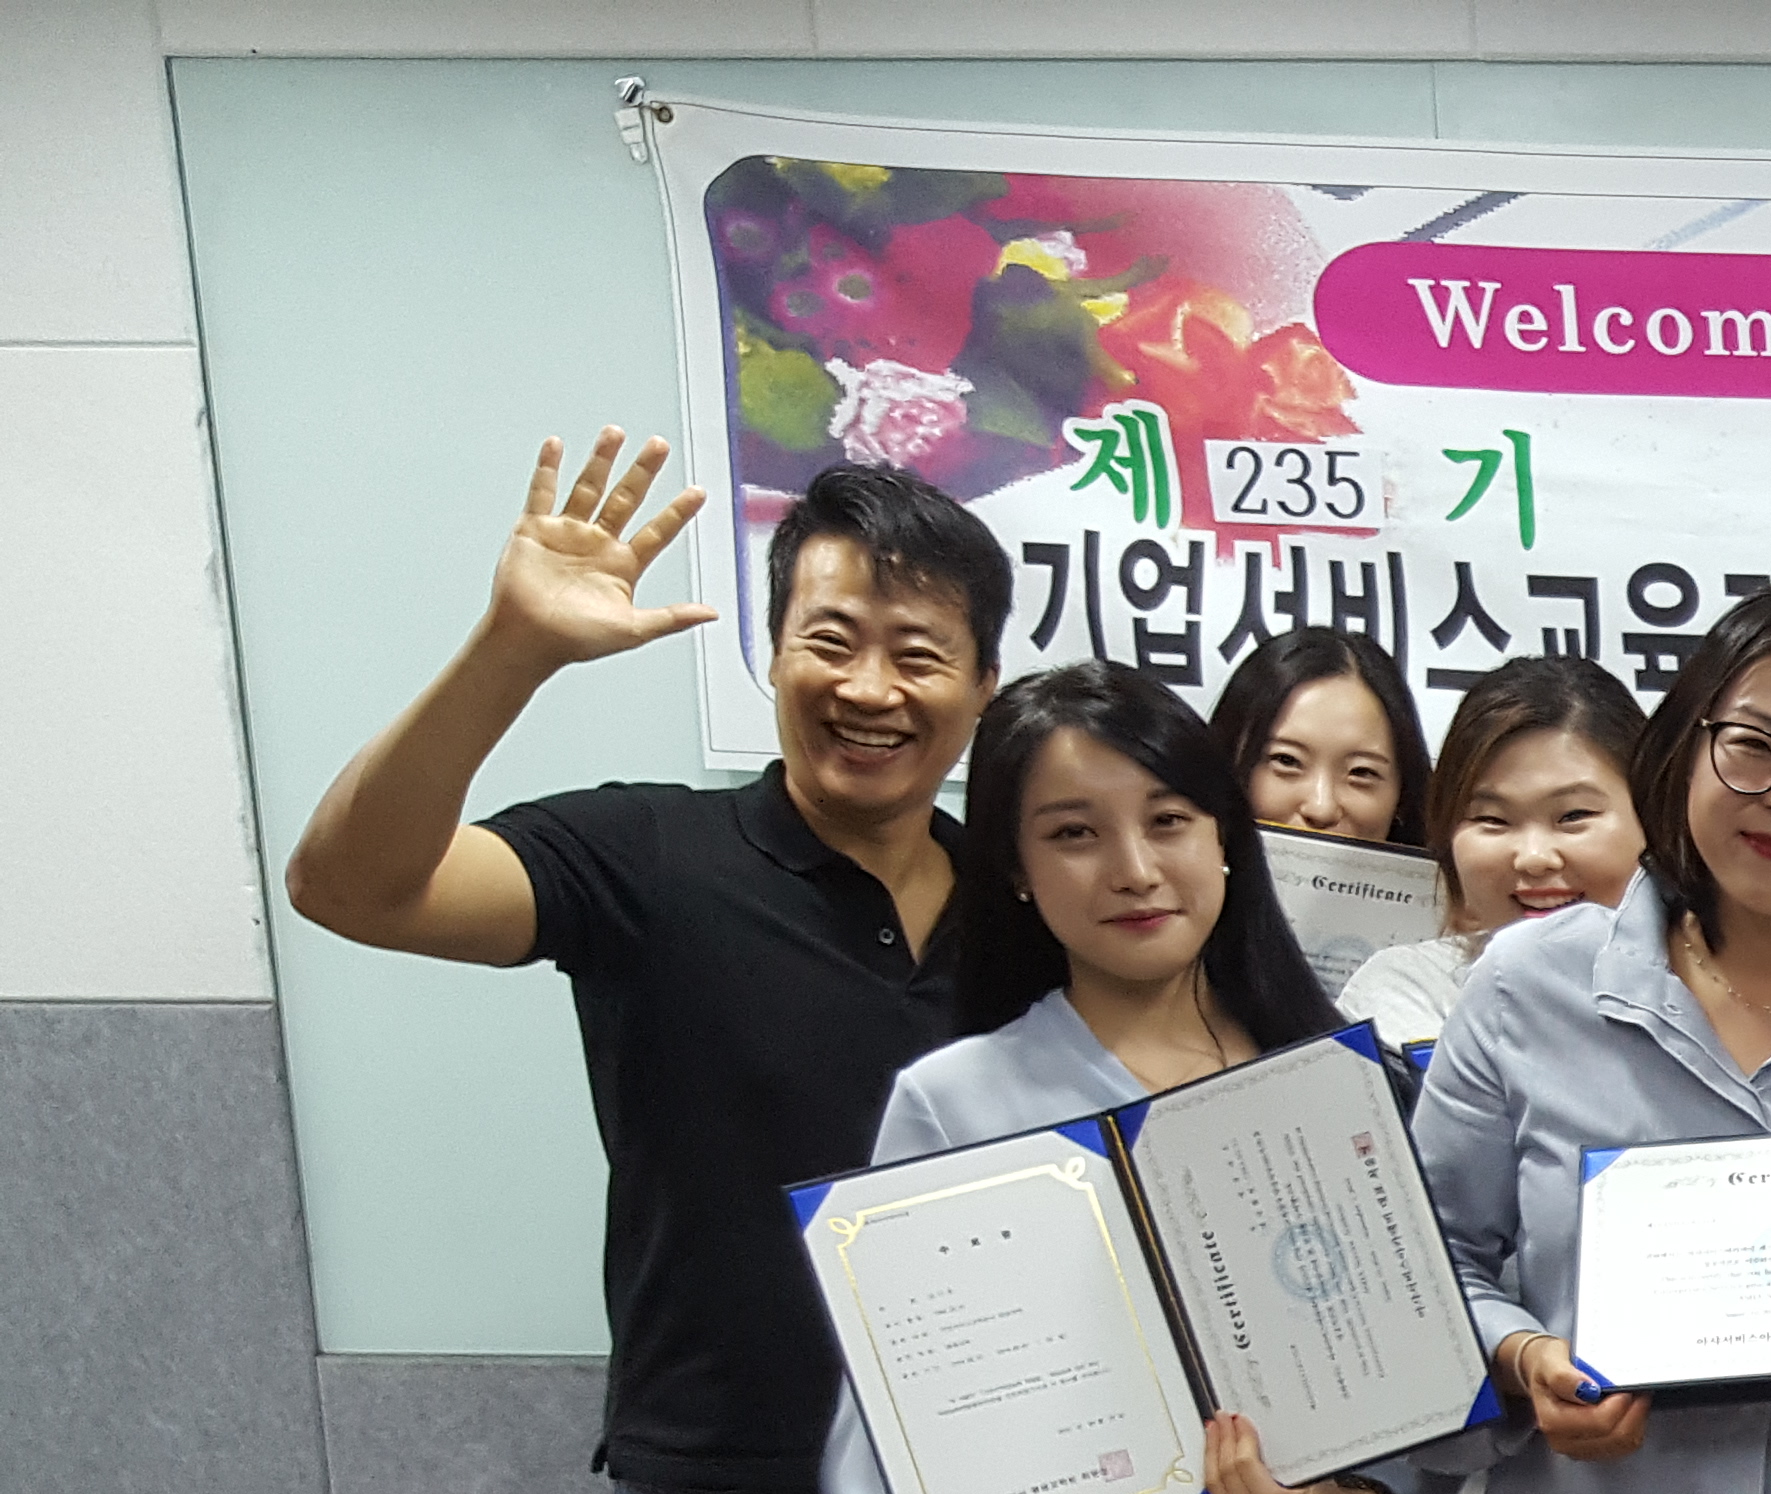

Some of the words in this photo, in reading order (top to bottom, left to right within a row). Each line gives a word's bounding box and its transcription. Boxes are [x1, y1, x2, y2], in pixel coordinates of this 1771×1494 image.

[1070, 409, 1170, 528] 제
[1226, 446, 1365, 519] 235
[1444, 429, 1536, 550] 기
[1312, 874, 1413, 904] Certificate
[1201, 1229, 1250, 1350] Certificate
